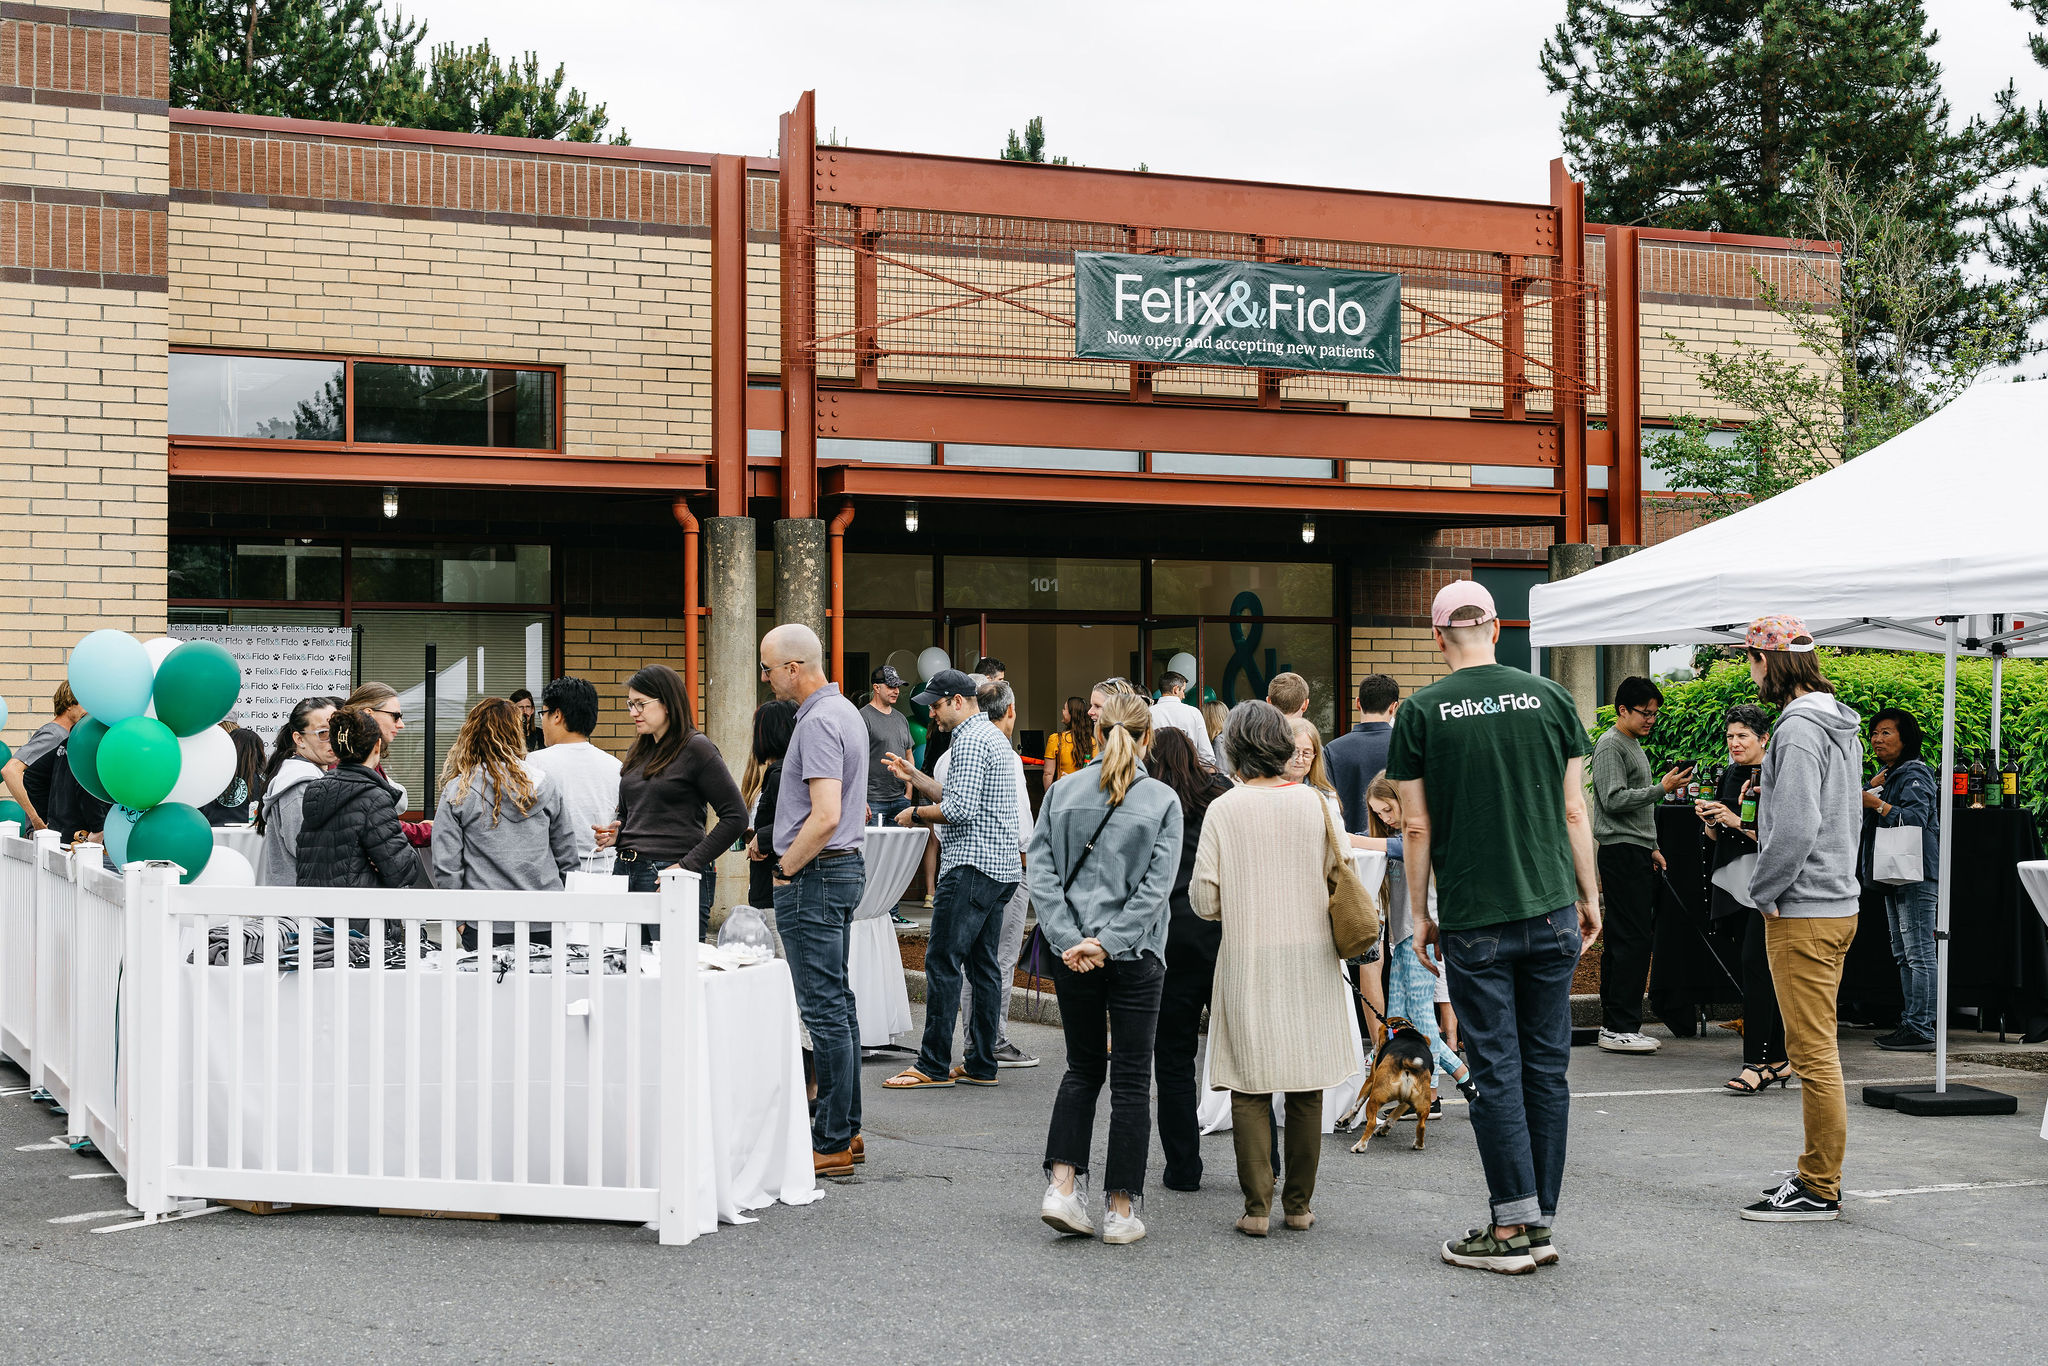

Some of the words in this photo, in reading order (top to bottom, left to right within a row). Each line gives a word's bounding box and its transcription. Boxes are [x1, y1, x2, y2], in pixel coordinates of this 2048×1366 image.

[1114, 273, 1366, 336] Felix&Fido
[1106, 330, 1142, 345] Now
[1145, 335, 1182, 350] open
[1184, 335, 1212, 349] and
[1215, 337, 1284, 356] accepting
[1286, 342, 1317, 355] new
[1319, 344, 1375, 359] patients
[1030, 577, 1059, 592] 101
[256, 637, 299, 646] Felix&Fido
[231, 652, 270, 661] elix&Fido
[282, 653, 325, 661] Felix&Fido
[255, 667, 298, 676] Felix&Fido
[281, 682, 324, 691] Felix&Fido
[255, 696, 298, 705] Felix&Fido
[1438, 692, 1542, 721] Felix&Fido
